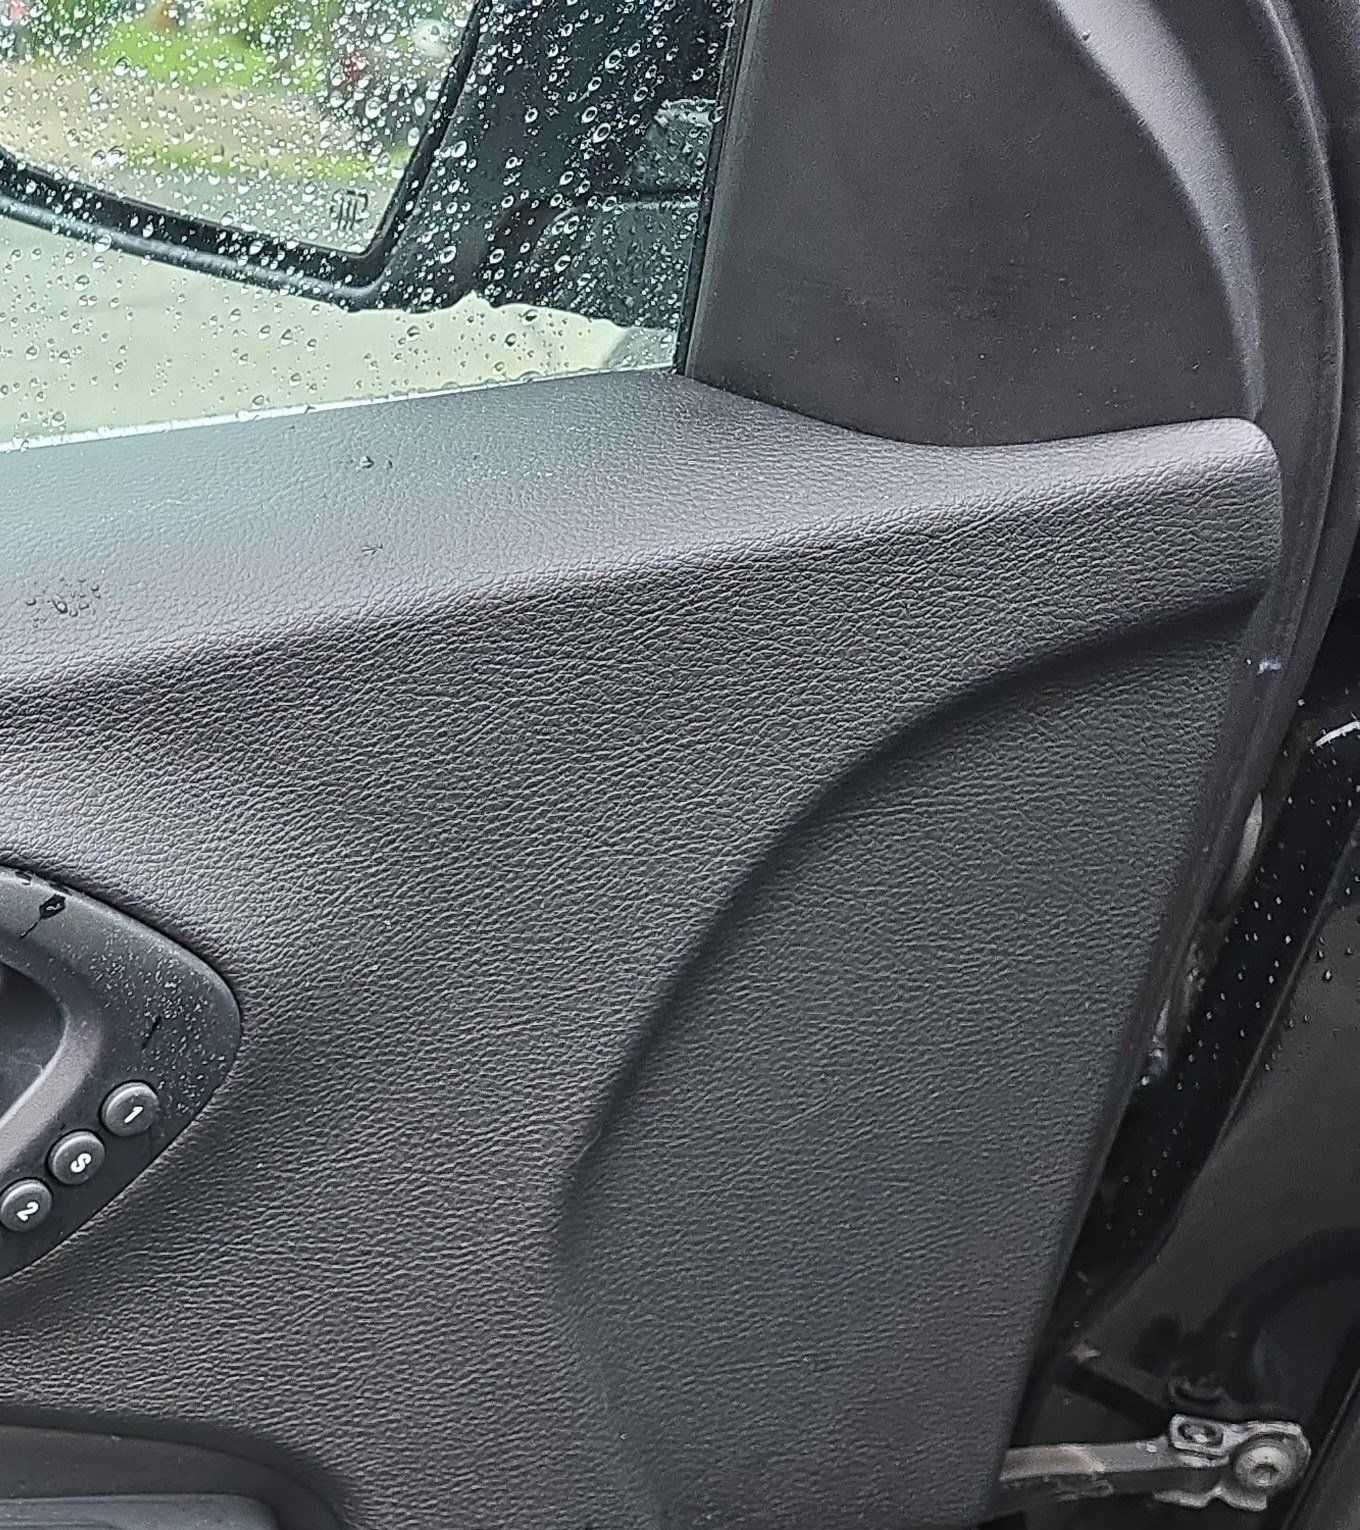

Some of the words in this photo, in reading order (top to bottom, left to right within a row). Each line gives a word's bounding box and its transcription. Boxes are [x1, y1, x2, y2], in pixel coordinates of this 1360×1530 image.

[123, 1105, 144, 1124] 1
[69, 1152, 92, 1174] S
[16, 1200, 40, 1222] 2
